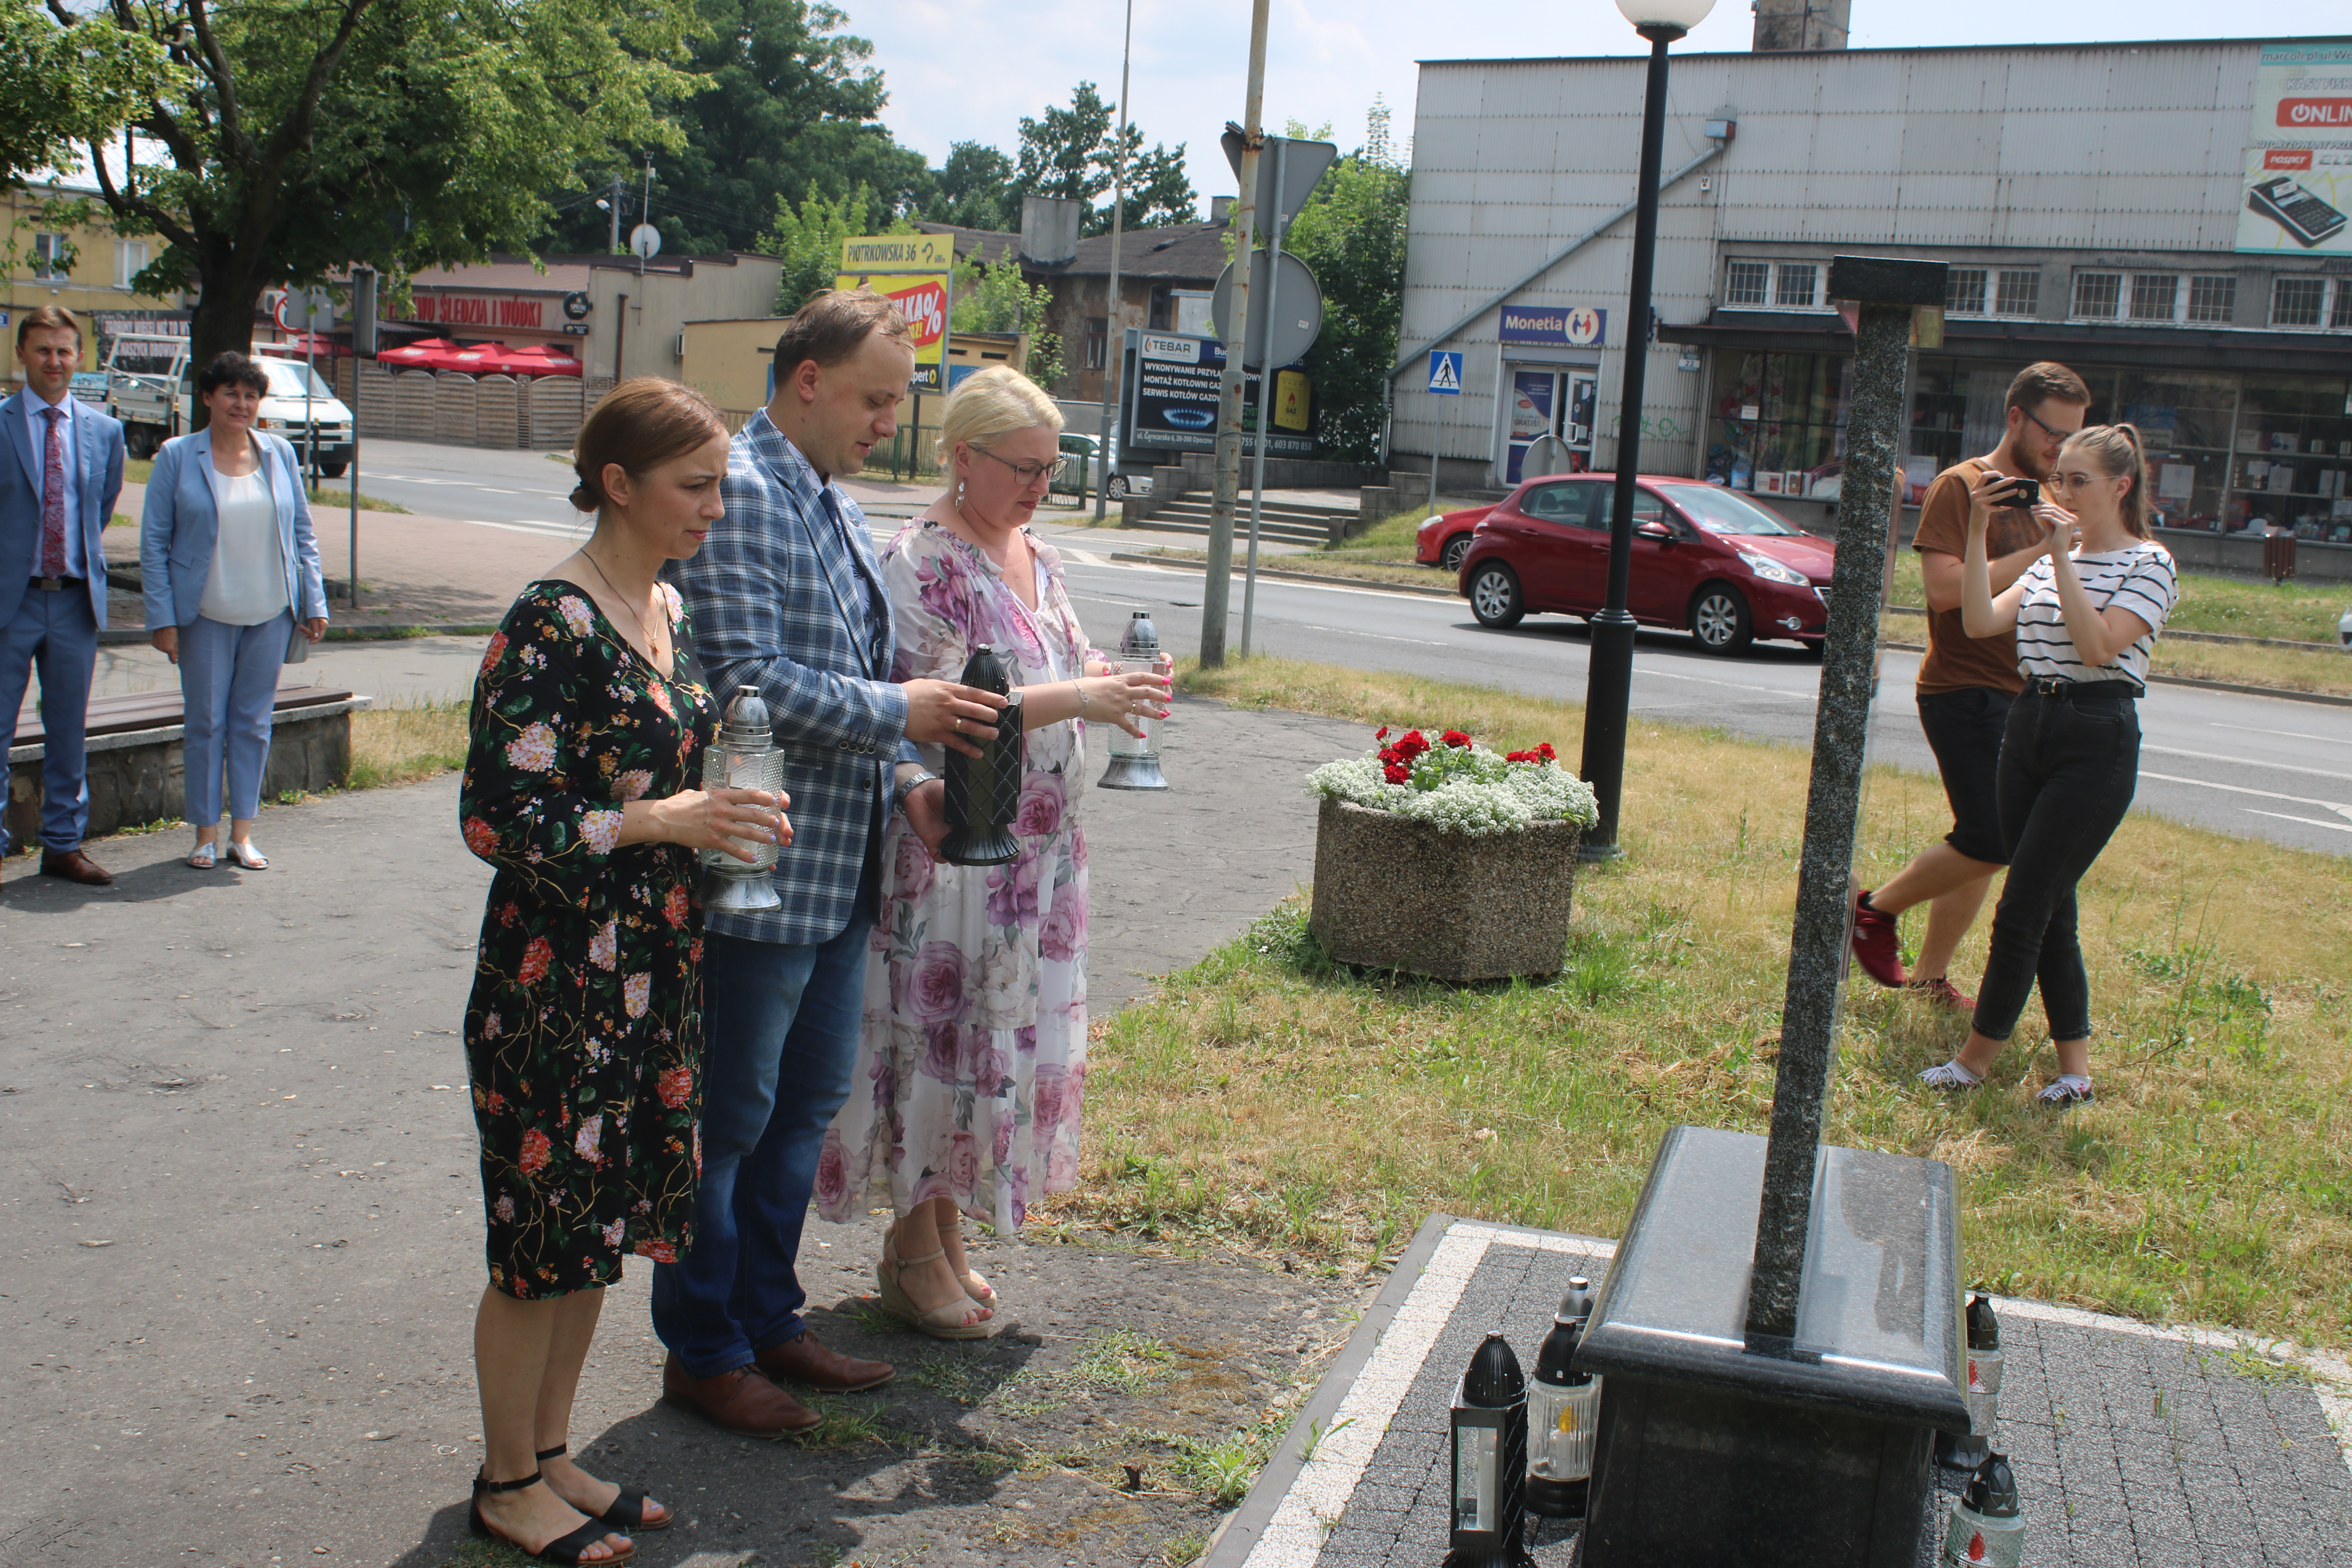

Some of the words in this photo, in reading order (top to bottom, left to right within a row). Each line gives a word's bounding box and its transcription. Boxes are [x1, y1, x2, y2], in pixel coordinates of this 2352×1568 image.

[2263, 51, 2317, 62] marcoli.pl
[2286, 78, 2321, 91] KASY
[848, 243, 904, 262] PIOTRKOWSKA
[905, 244, 916, 261] 36
[439, 292, 487, 325] ŚLEDZIA
[499, 295, 542, 328] WÓDKI
[1505, 315, 1563, 331] Monetia
[1152, 340, 1191, 353] TEBAR
[911, 370, 929, 385] pert
[1145, 362, 1196, 375] WYKONYWANIE
[1197, 368, 1221, 379] PRZYŁĄ
[1144, 375, 1172, 385] MONTAŻ
[1173, 378, 1208, 388] KOTŁOWNI
[1209, 381, 1221, 390] GAZ
[1143, 388, 1169, 397] SERWIS
[1170, 390, 1198, 400] KOTŁÓW
[1275, 440, 1286, 448] 603
[1288, 441, 1299, 450] 870
[1300, 442, 1312, 450] 858
